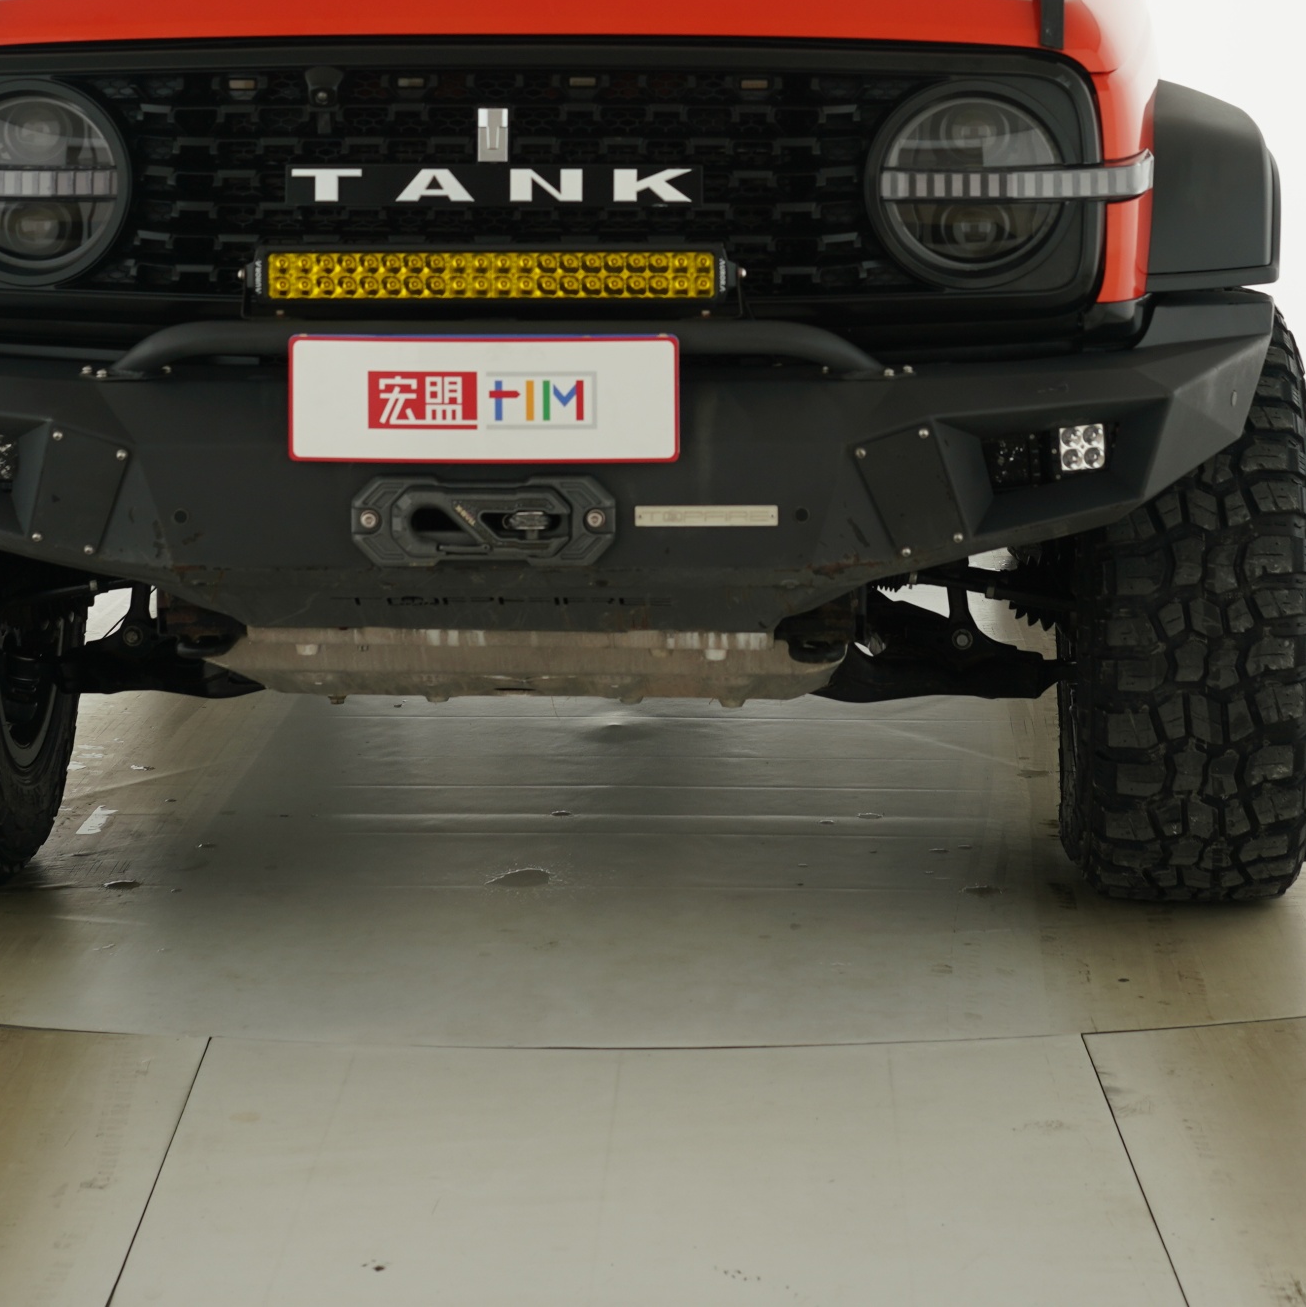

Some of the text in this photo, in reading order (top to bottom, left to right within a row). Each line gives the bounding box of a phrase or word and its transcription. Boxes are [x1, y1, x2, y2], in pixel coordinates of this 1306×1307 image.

[291, 168, 692, 202] TANK
[254, 259, 262, 294] AURORA
[718, 257, 726, 292] AURORA
[379, 375, 465, 425] 宏盟
